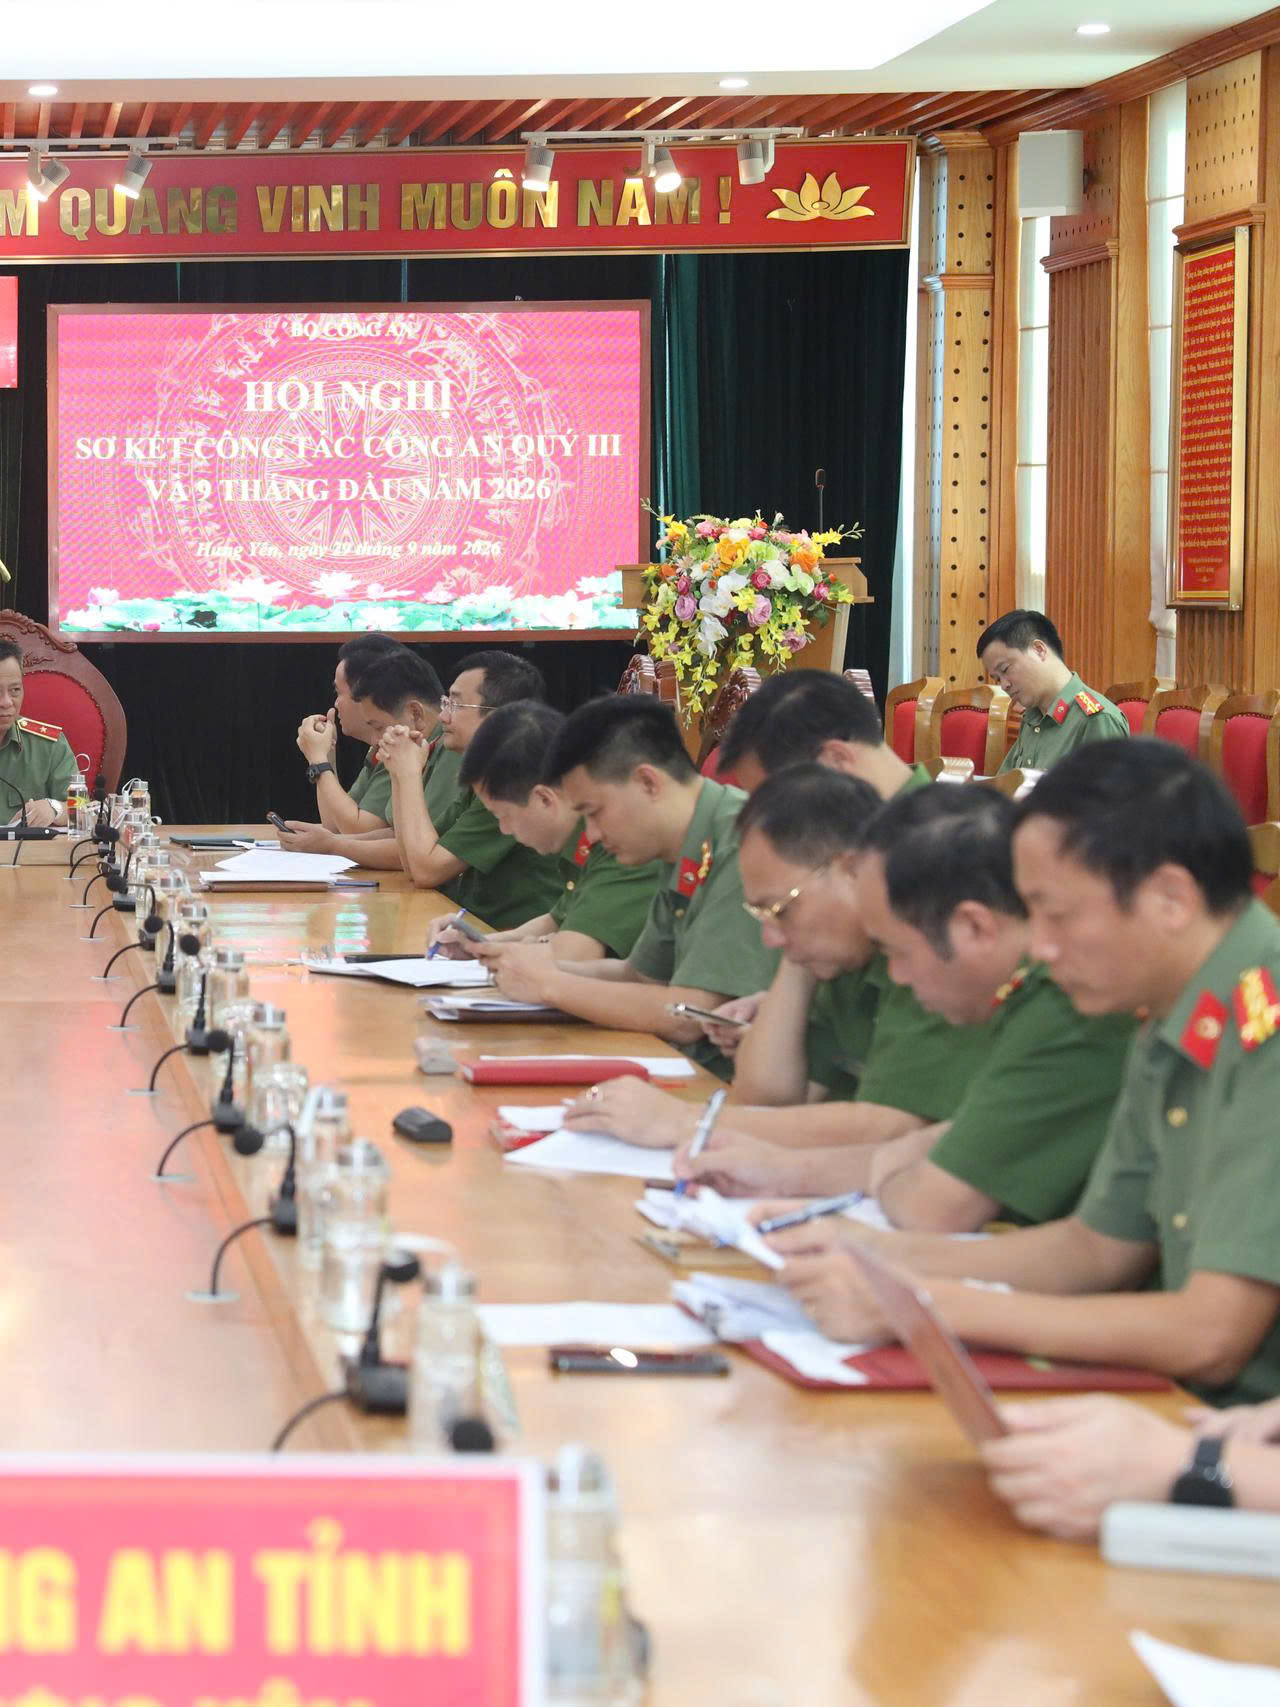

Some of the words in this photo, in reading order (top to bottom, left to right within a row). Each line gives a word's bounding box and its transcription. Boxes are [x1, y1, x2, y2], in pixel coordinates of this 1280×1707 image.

[58, 185, 238, 241] QUANG
[256, 182, 380, 233] VINH
[401, 168, 559, 232] MUÔN
[577, 166, 701, 227] NĂM
[718, 175, 732, 225] !
[384, 319, 415, 338] AN
[243, 376, 325, 421] HỘI
[337, 379, 455, 419] NGHỊ
[75, 434, 117, 460] SƠ
[122, 430, 190, 459] KẾT
[194, 430, 281, 459] CÔNG
[293, 429, 355, 459] TÁC
[363, 429, 456, 458] CÔNG
[460, 433, 509, 457] AN
[511, 428, 578, 459] QUÝ
[587, 433, 623, 456] III
[145, 473, 190, 501] VÀ
[196, 479, 212, 501] 9
[219, 473, 330, 501] THÁNG
[338, 468, 416, 501] ĐẦU
[417, 472, 483, 501] NĂM
[488, 477, 552, 500] 2026
[408, 541, 418, 556] 9
[99, 1547, 233, 1656] AN
[253, 1517, 471, 1658] TỈNH
